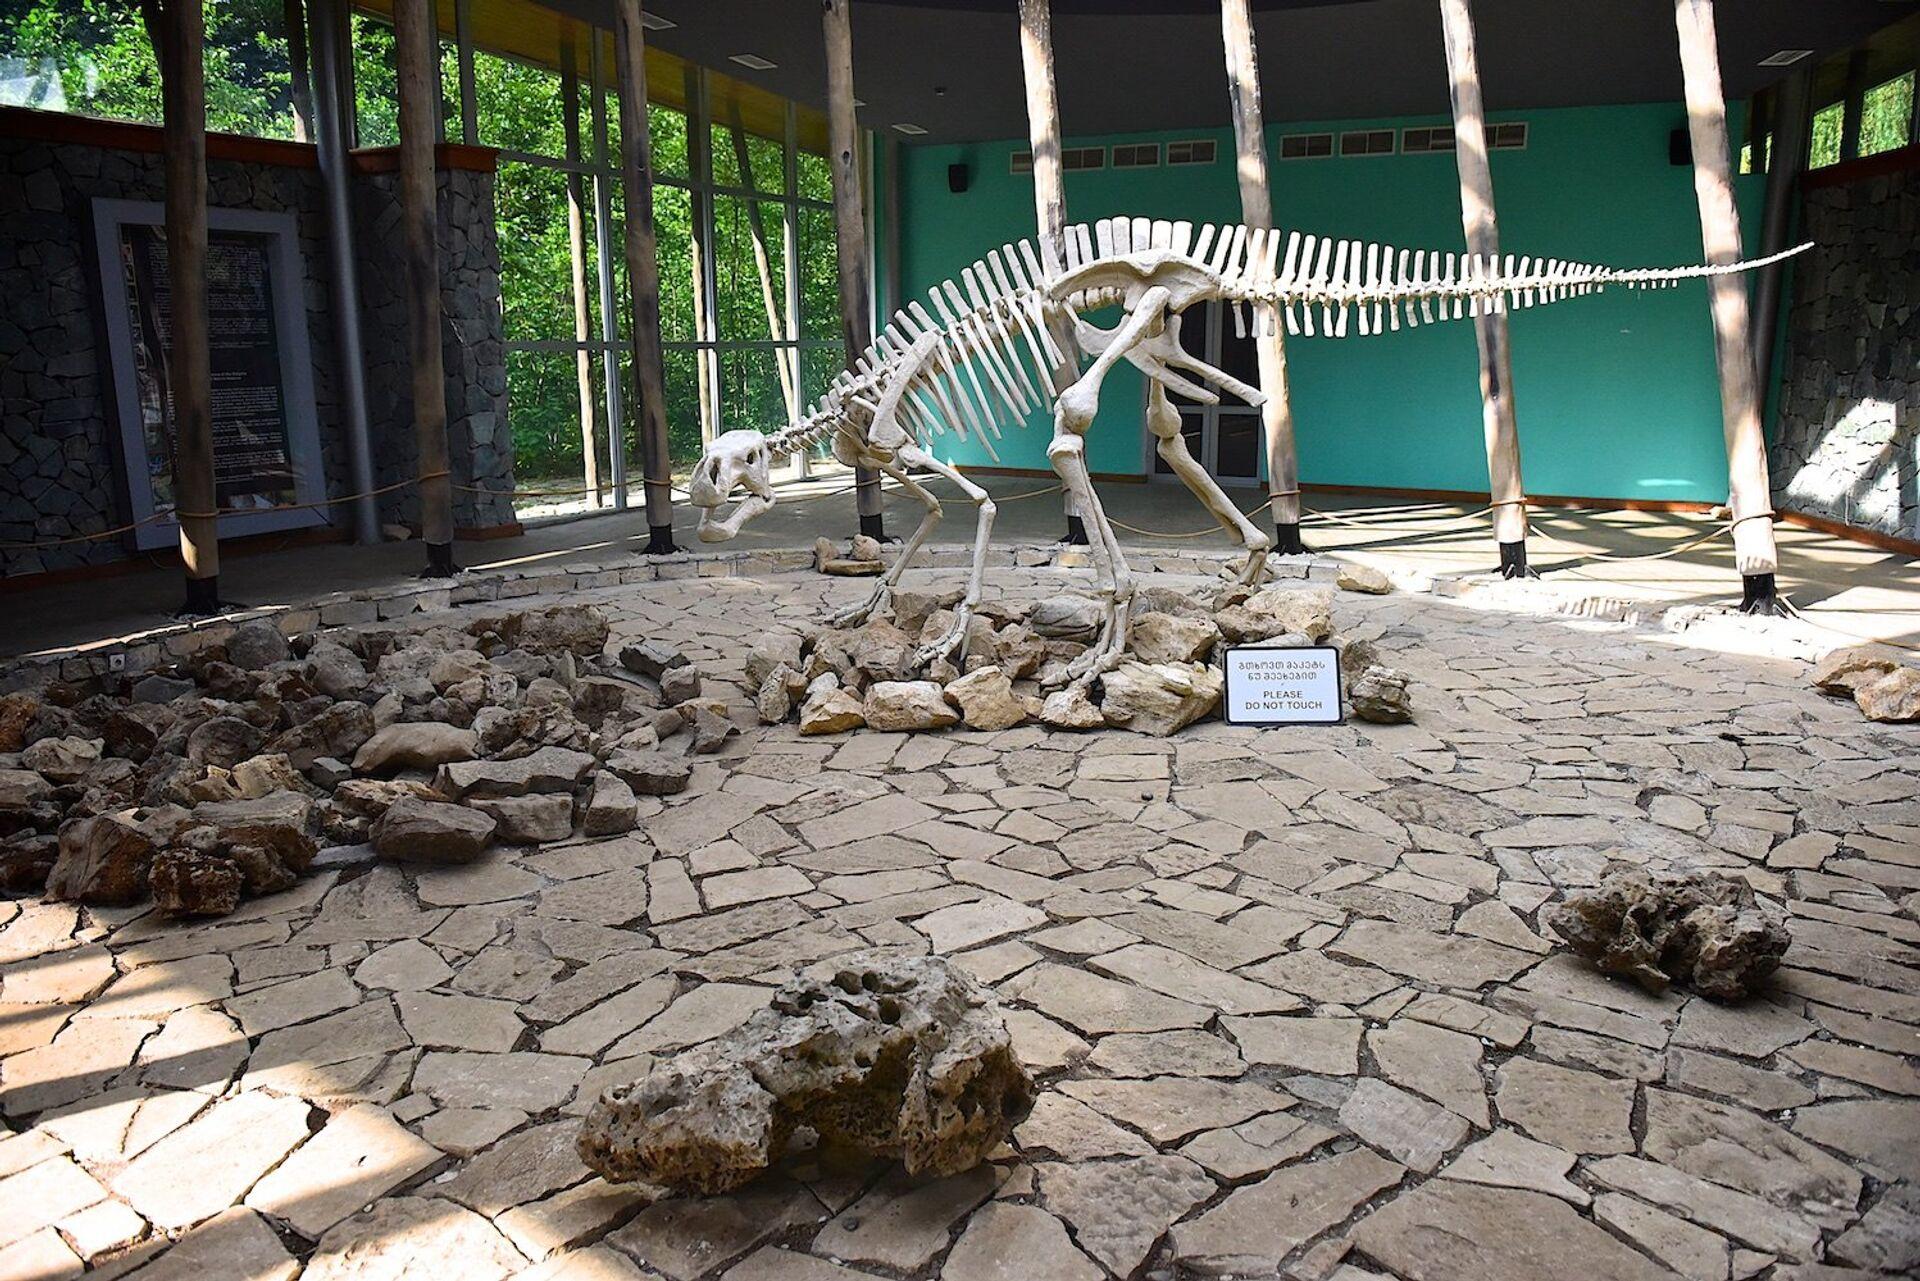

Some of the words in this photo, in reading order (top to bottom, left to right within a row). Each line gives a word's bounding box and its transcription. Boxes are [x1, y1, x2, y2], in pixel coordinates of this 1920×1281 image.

[1248, 672, 1261, 681] ნუ
[1263, 690, 1303, 699] PLEASE
[1245, 701, 1260, 710] DO
[1263, 701, 1284, 710] NOT
[1287, 701, 1323, 709] TOUCH
